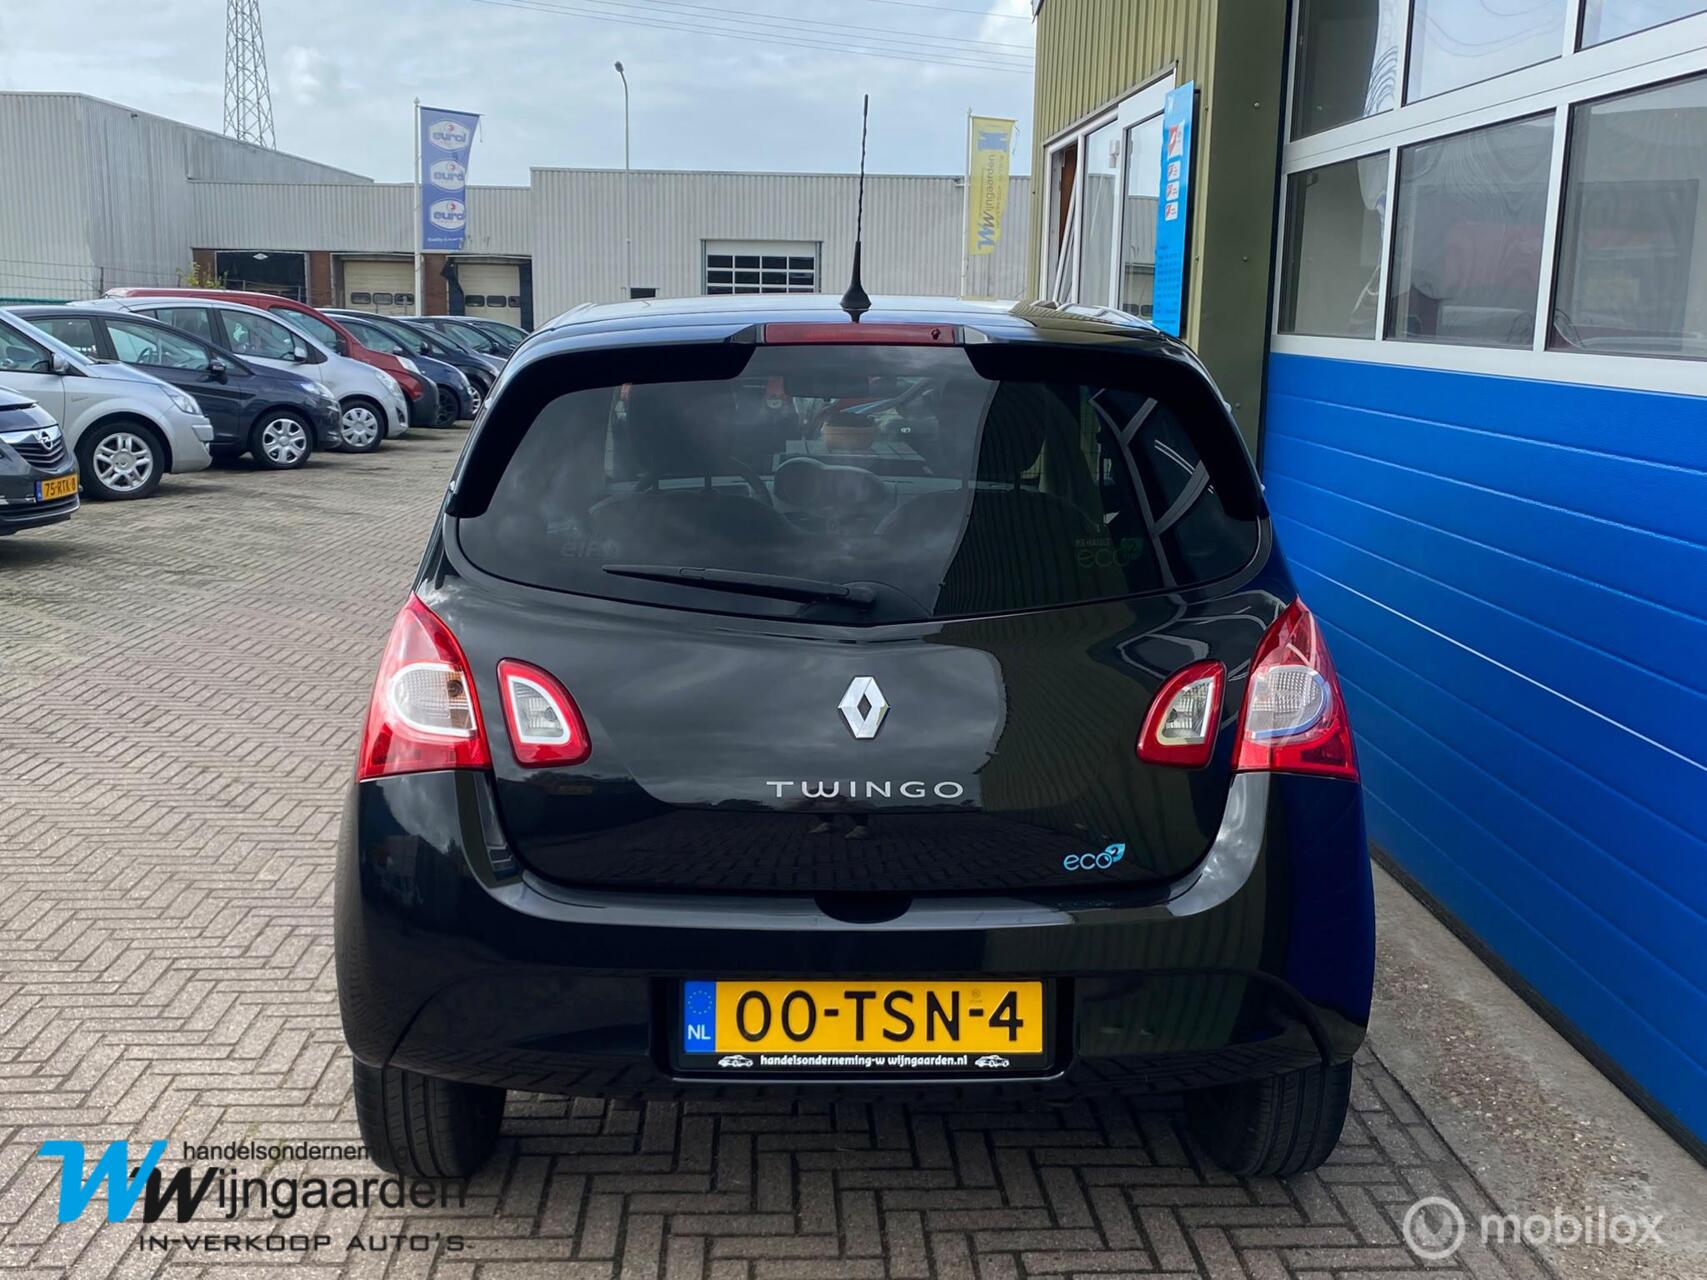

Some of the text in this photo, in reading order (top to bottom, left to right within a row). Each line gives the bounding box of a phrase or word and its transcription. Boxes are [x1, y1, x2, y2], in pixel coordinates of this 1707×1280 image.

[766, 780, 964, 799] TWINGO
[735, 989, 1025, 1043] 00-TSN-4
[687, 1024, 712, 1041] NL
[887, 1054, 968, 1067] wijngaarden.nl
